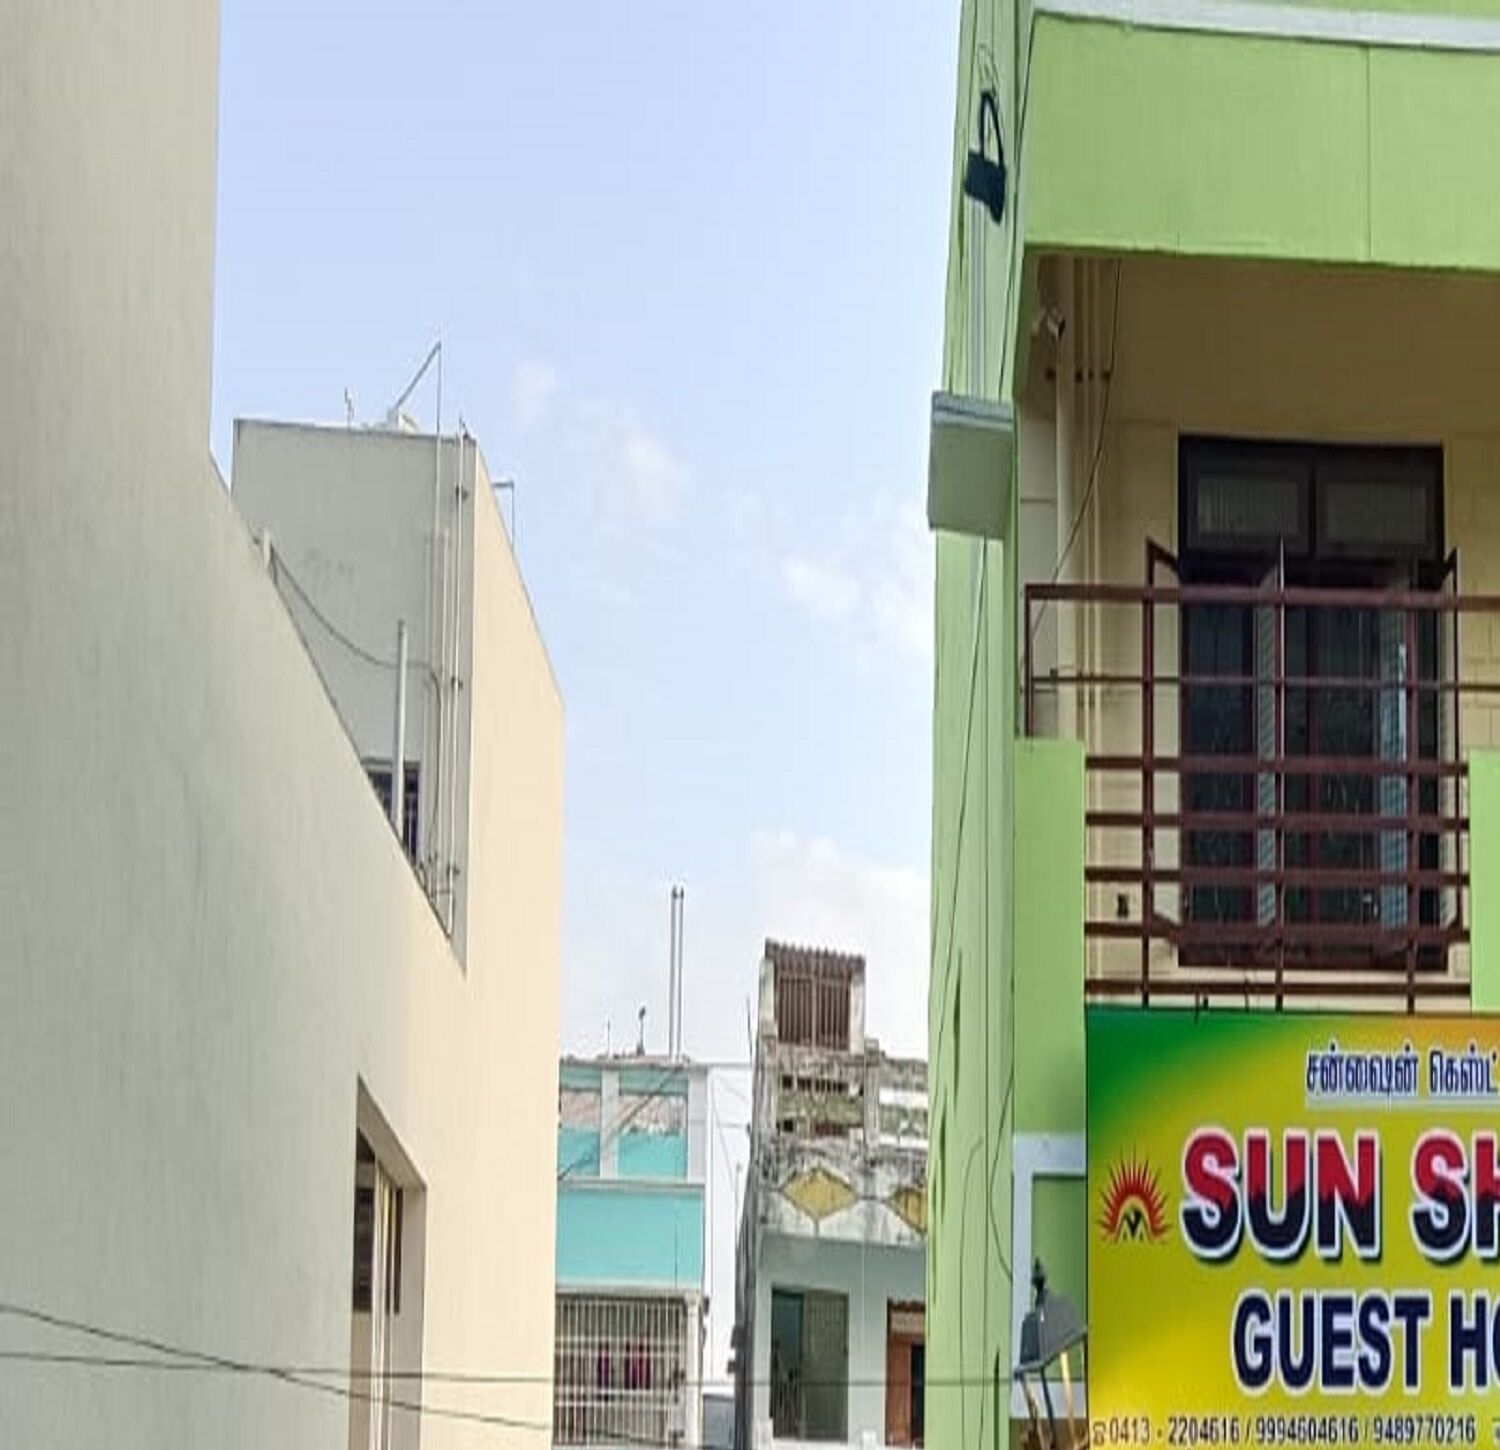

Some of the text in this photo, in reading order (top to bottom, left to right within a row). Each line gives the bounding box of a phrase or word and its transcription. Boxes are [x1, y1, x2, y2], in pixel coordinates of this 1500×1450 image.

[1180, 1129, 1380, 1258] SUN
[1231, 1291, 1431, 1394] GUEST
[1109, 1416, 1151, 1447] 0413
[1167, 1416, 1241, 1446] 2204616
[1255, 1415, 1359, 1444] 9994604616
[1373, 1413, 1477, 1443] 9489770216
